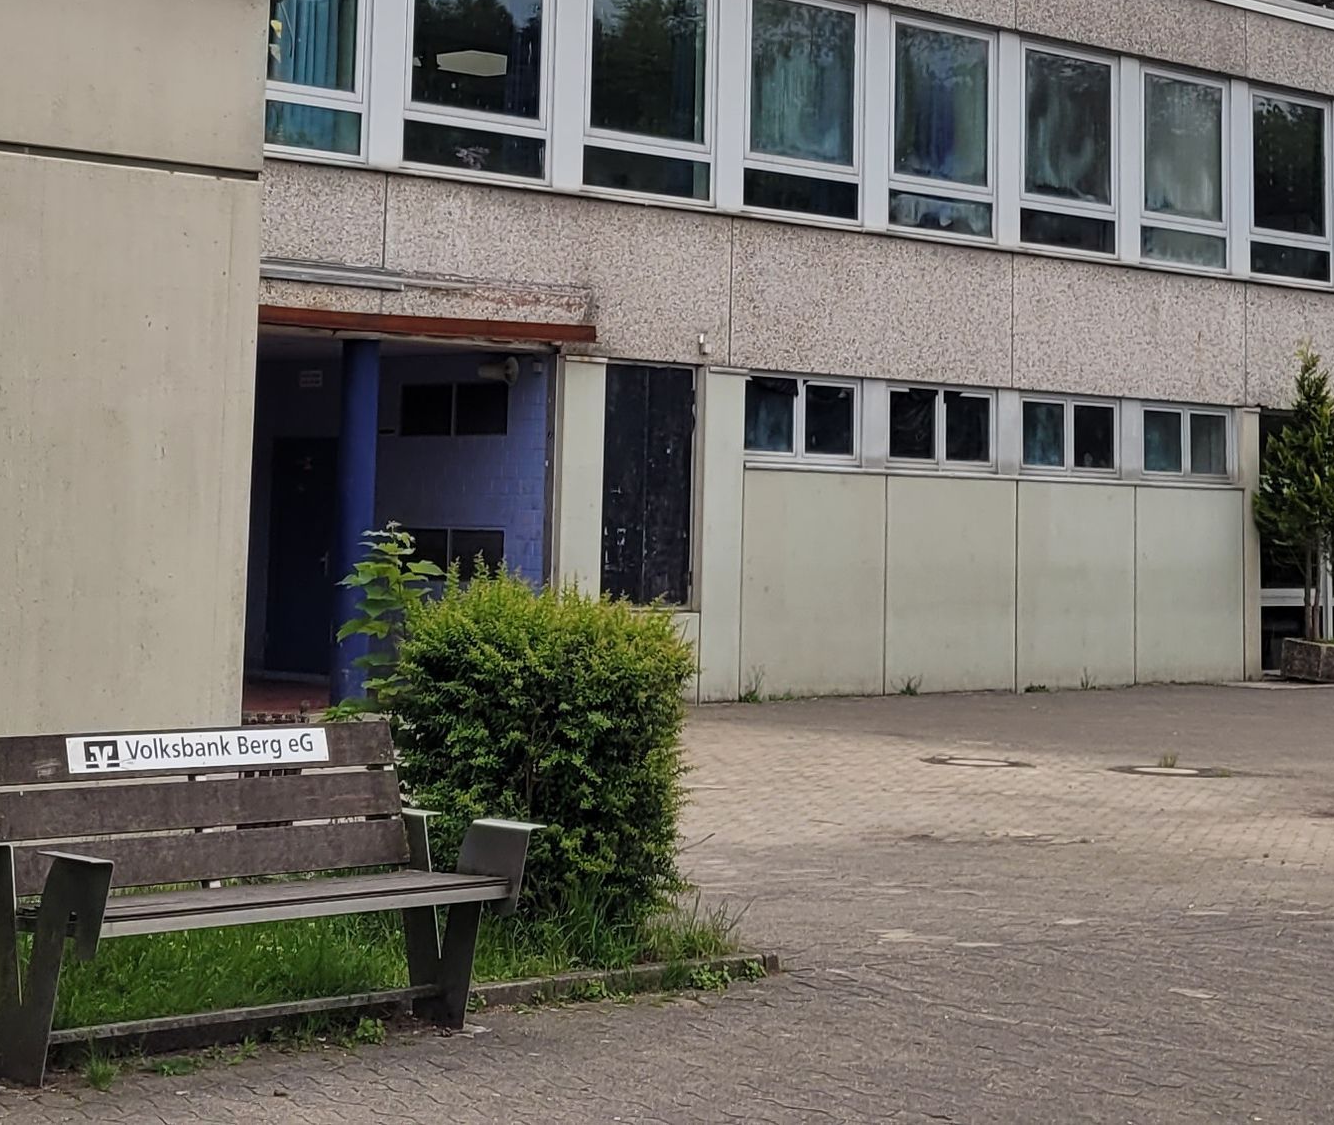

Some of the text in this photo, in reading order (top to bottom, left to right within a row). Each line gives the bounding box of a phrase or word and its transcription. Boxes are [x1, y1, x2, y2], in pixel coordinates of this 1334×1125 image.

[125, 733, 314, 760] Volksbank Berg eG
